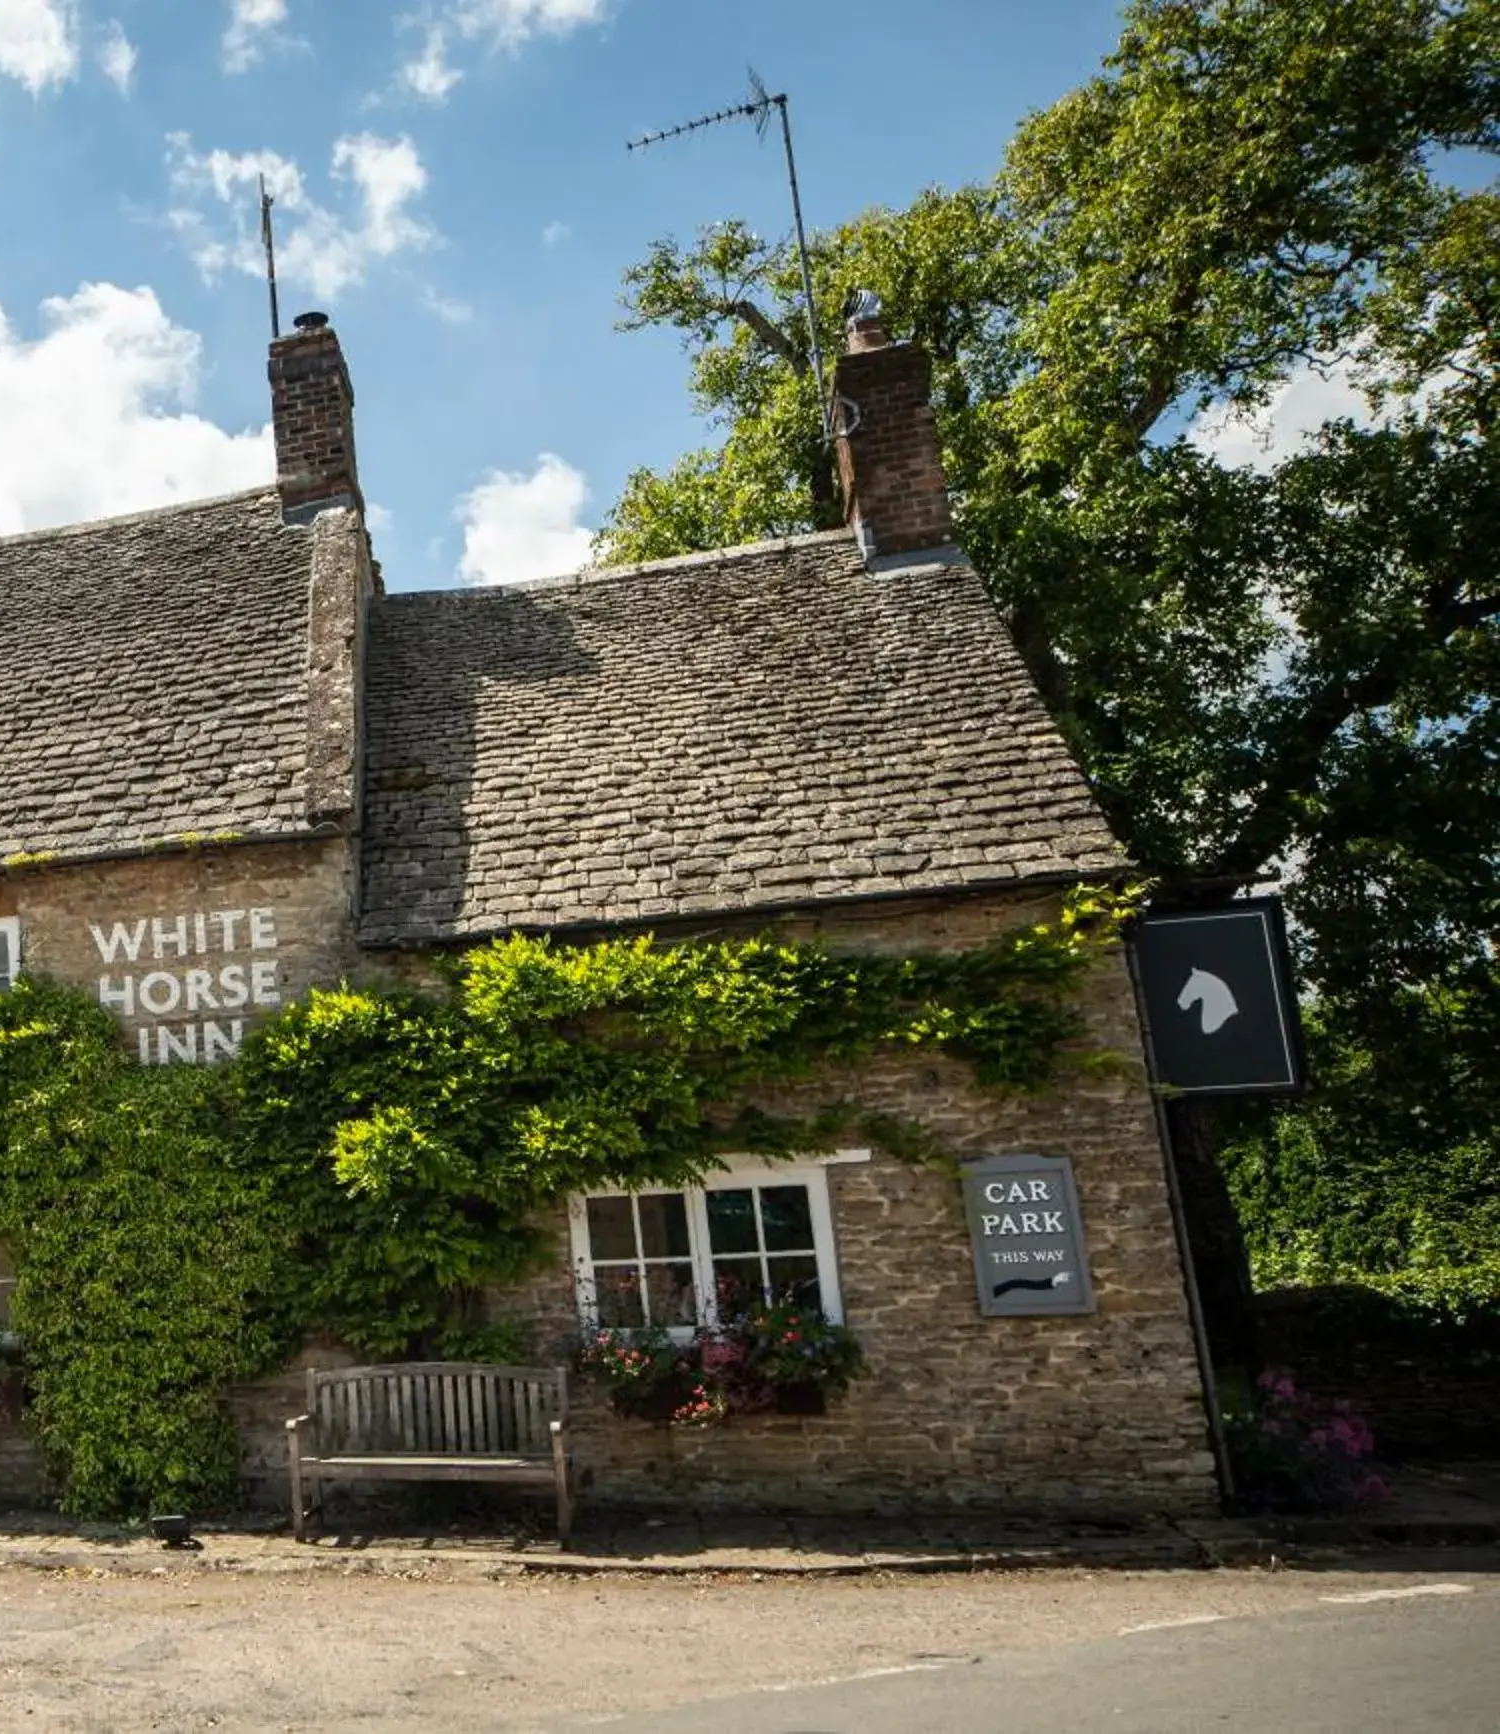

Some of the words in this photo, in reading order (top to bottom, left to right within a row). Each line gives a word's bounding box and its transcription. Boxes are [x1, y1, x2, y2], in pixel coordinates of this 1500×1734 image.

[89, 907, 277, 963] WHITE
[100, 960, 281, 1016] HORSE
[139, 1020, 245, 1066] INN
[985, 1180, 1050, 1203] CAR
[981, 1211, 1065, 1235] PARK
[991, 1252, 1029, 1264] THIS
[1033, 1250, 1064, 1262] WAY
